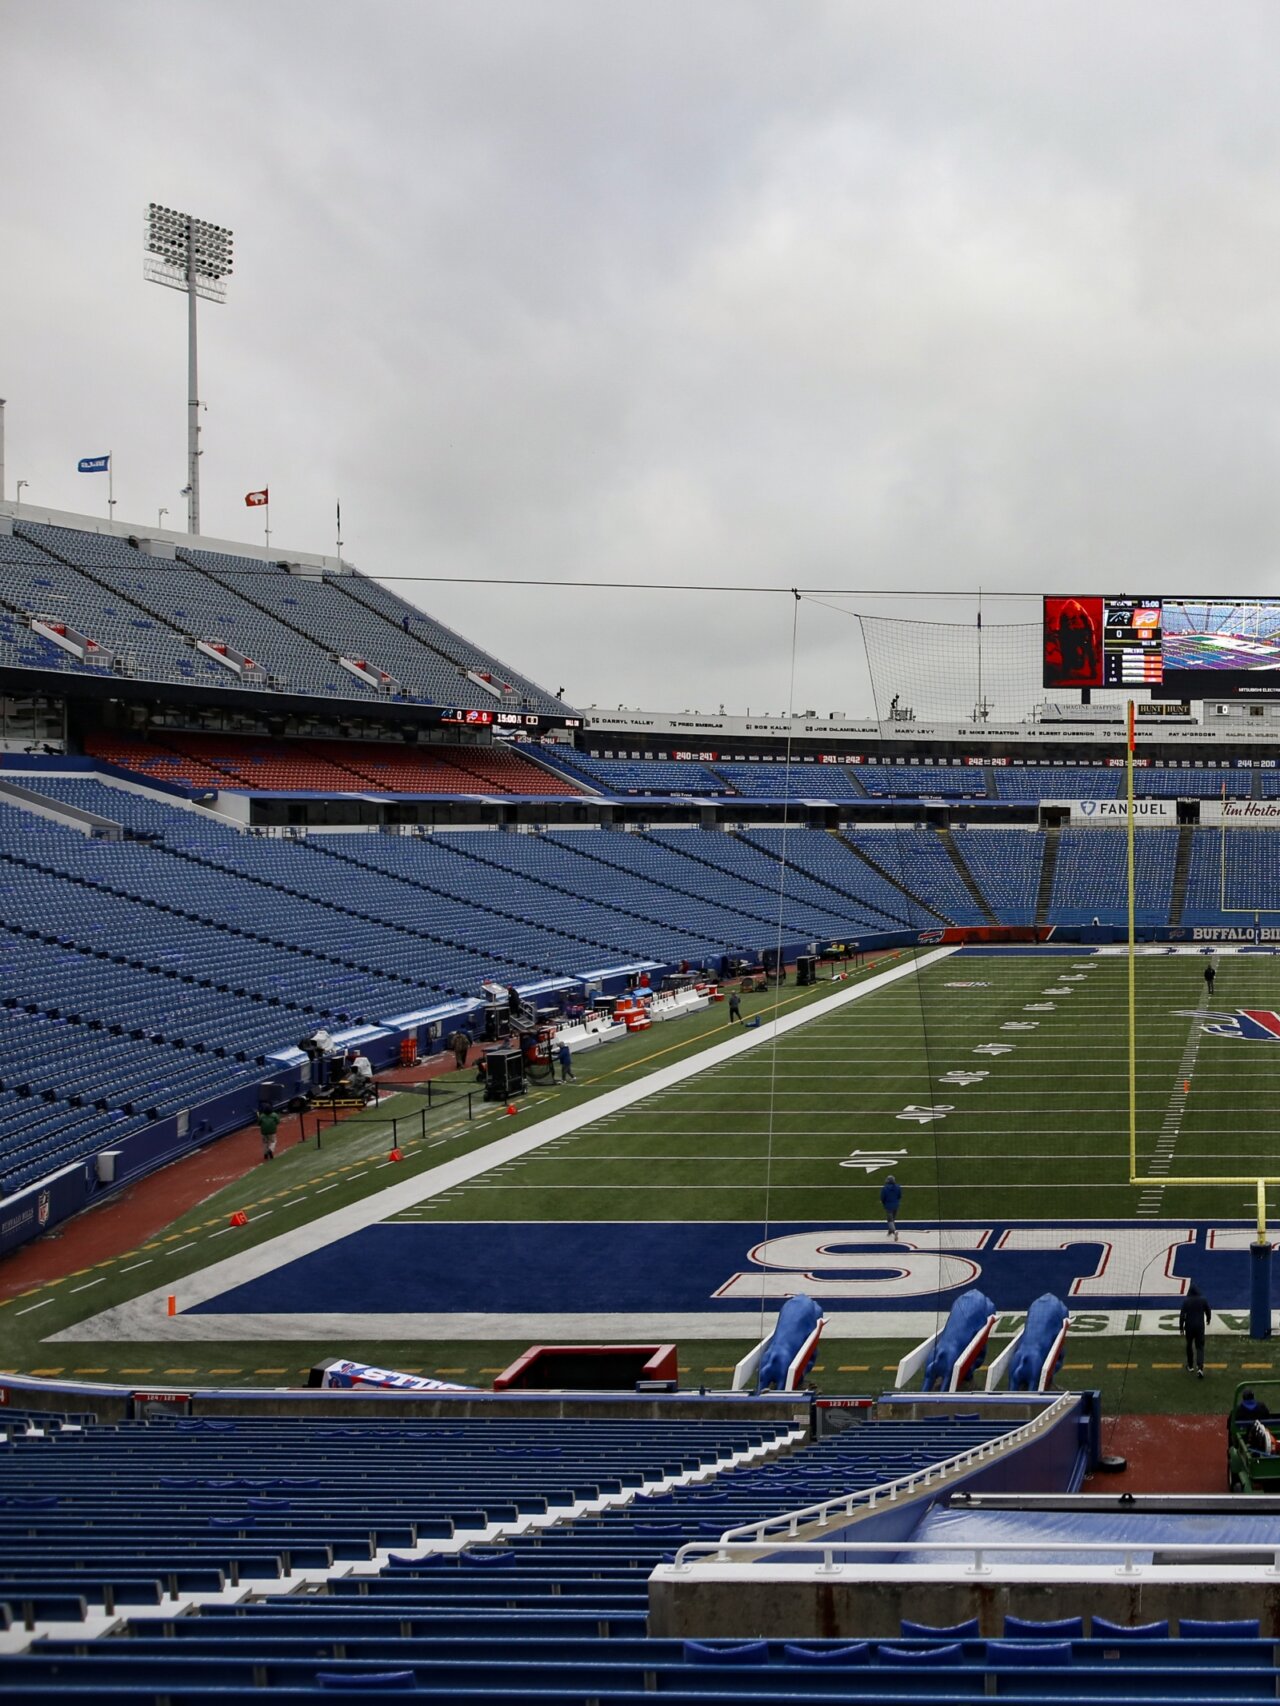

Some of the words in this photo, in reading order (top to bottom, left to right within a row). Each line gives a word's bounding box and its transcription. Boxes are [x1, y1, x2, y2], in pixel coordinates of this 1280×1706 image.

[1141, 600, 1159, 608] 15:00
[1116, 630, 1122, 638] 0
[1167, 705, 1189, 713] HUNT
[456, 710, 462, 720] 0
[482, 712, 487, 721] 0
[497, 713, 517, 724] 15:00
[676, 752, 691, 760] 240
[699, 752, 713, 761] 241
[822, 755, 837, 763] 241
[845, 756, 861, 764] 242
[968, 758, 984, 766] 242
[991, 758, 1007, 766] 243
[1109, 759, 1124, 767] 243
[1132, 759, 1147, 767] 244
[1260, 760, 1276, 768] 200
[1221, 801, 1242, 816] Tim
[1193, 928, 1254, 940] BUFFALO
[895, 1104, 955, 1121] 20
[838, 1148, 908, 1170] 10
